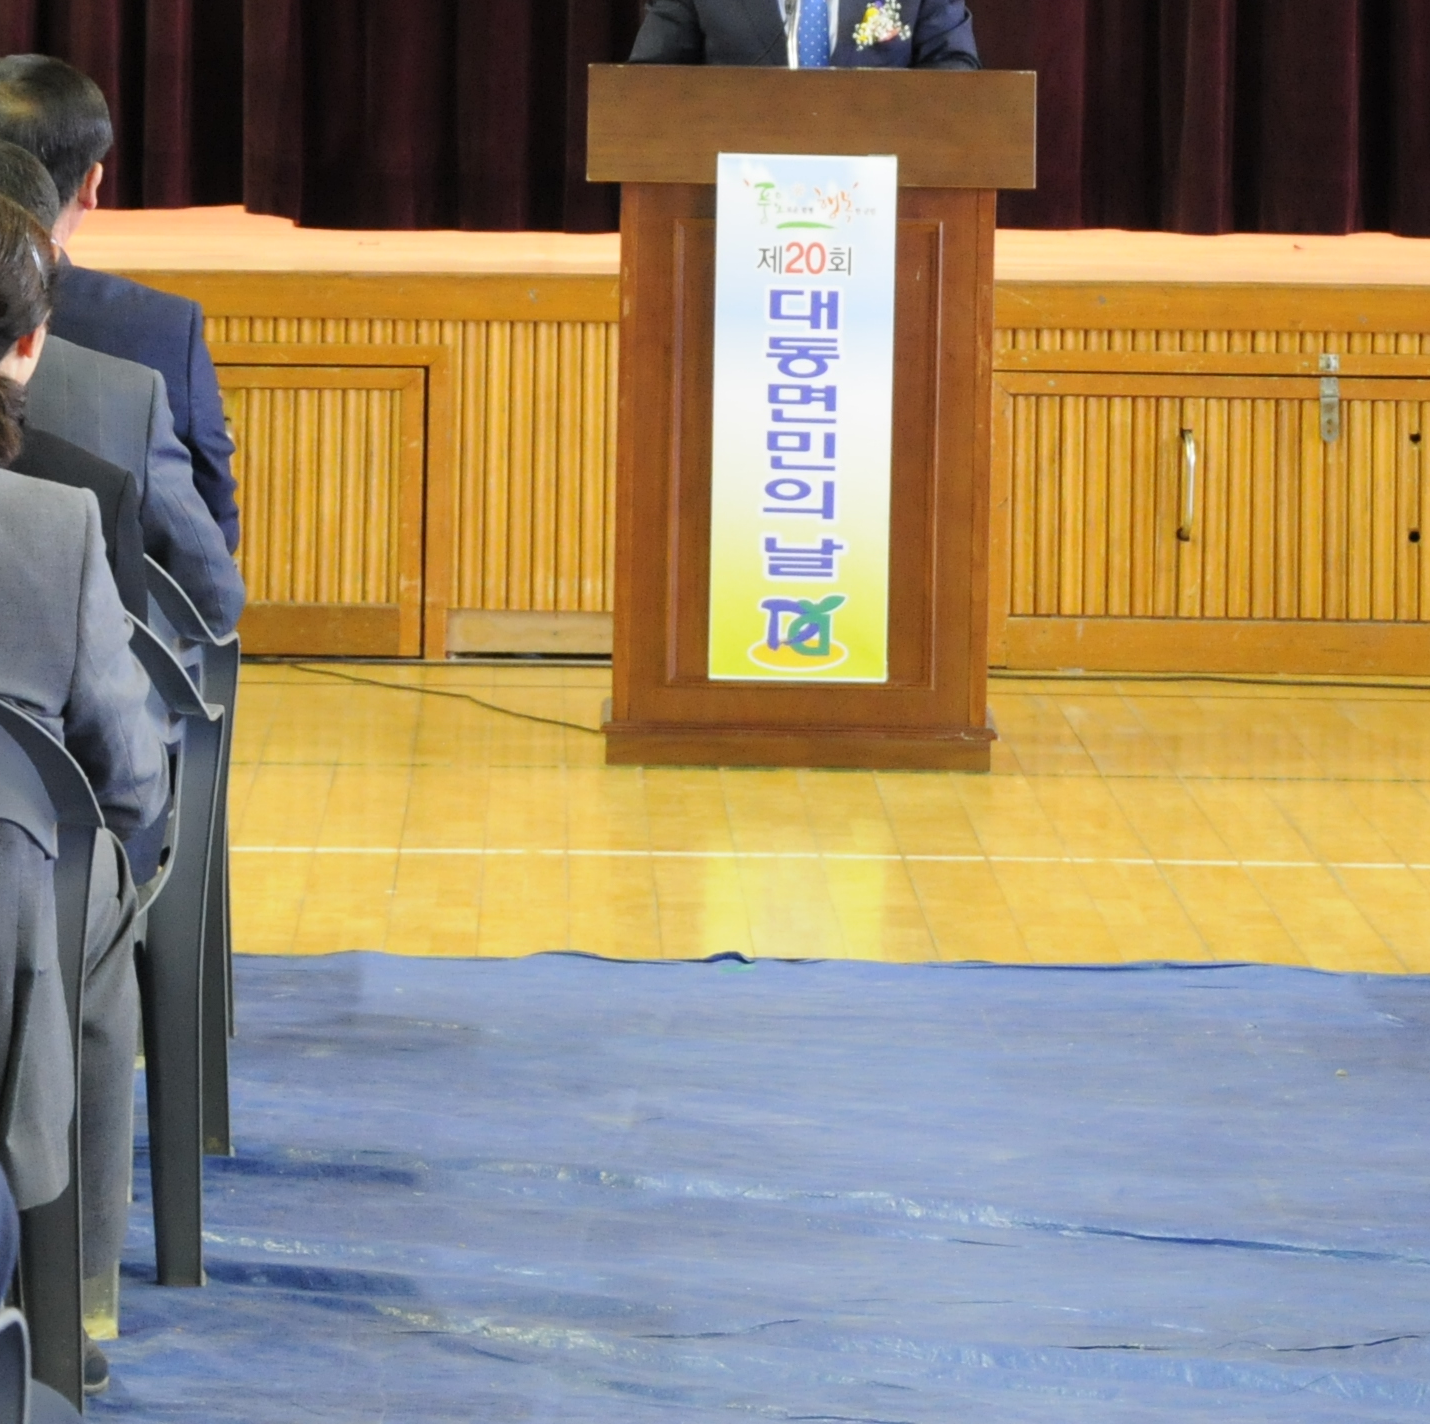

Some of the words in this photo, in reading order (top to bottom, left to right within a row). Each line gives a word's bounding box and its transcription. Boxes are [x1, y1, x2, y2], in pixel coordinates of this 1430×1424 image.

[757, 242, 851, 275] 제20회
[761, 290, 839, 521] 대동면민의
[763, 537, 844, 579] 날
